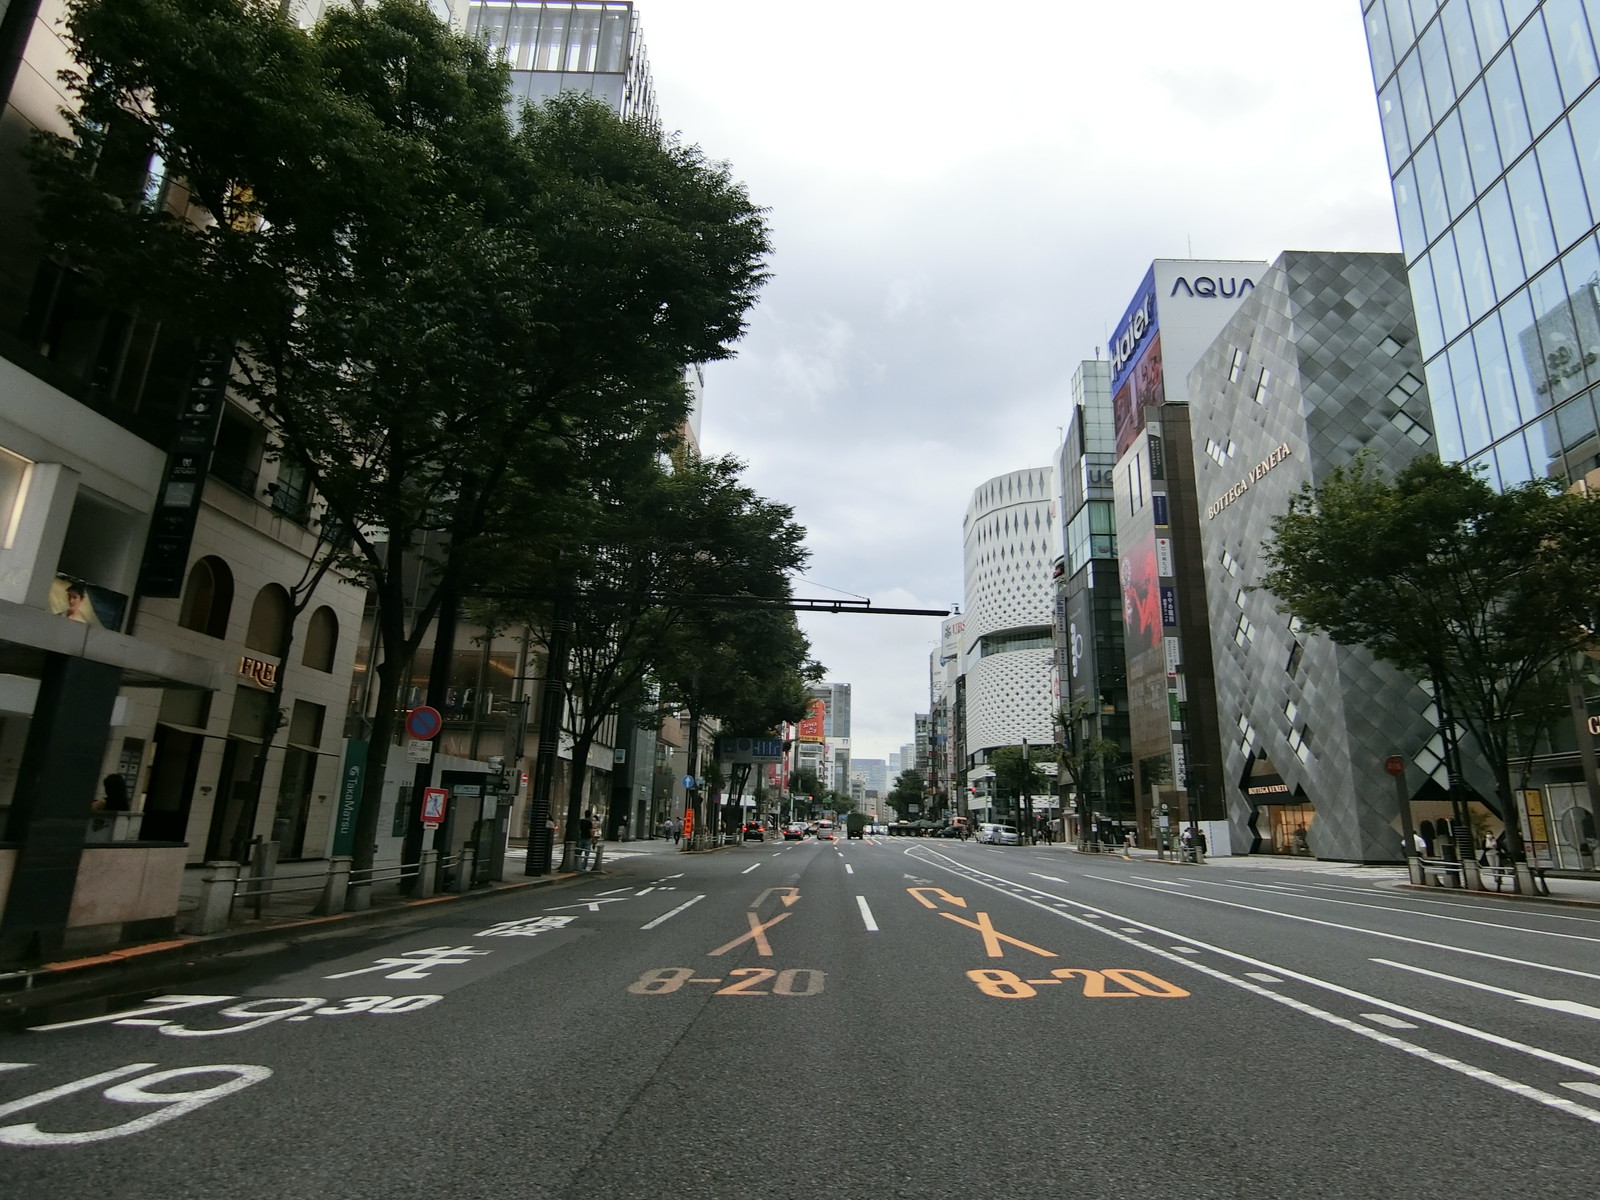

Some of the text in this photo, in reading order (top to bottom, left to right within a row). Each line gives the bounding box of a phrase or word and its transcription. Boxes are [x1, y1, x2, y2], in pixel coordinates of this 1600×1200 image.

[1170, 276, 1255, 298] AQUA
[1110, 293, 1153, 382] Haier
[1208, 479, 1249, 520] BOTTEGA
[1248, 442, 1291, 484] VENETA
[240, 656, 277, 688] FRE
[1588, 715, 1600, 734] G
[627, 968, 824, 997] 8-20
[966, 968, 1190, 999] 8-20
